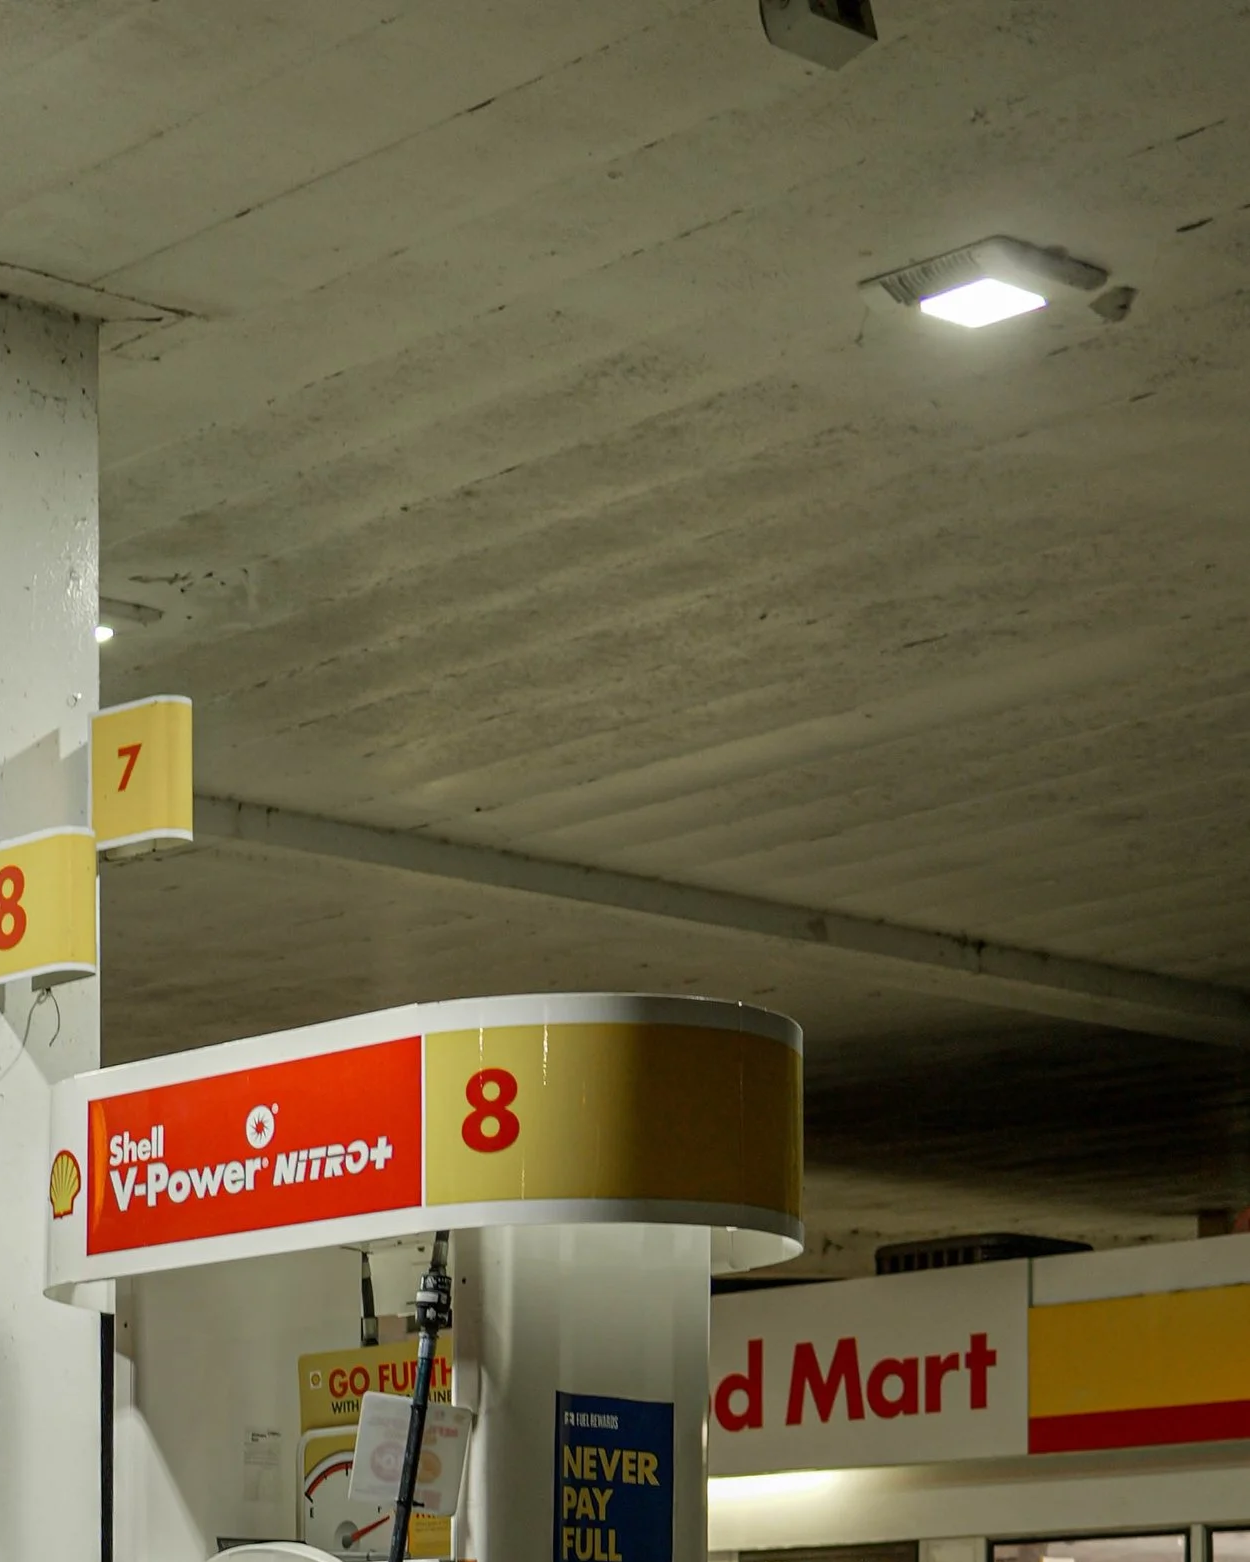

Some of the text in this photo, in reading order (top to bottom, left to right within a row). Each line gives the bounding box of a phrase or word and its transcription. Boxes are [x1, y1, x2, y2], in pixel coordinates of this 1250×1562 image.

[117, 743, 142, 792] 7
[461, 1067, 520, 1153] 8
[109, 1124, 164, 1166] Shell
[110, 1156, 263, 1212] V-Power
[329, 1366, 370, 1398] GO
[785, 1332, 997, 1426] Mart
[332, 1399, 359, 1414] WITH
[563, 1444, 660, 1486] NEVER
[563, 1486, 613, 1521] PAY
[563, 1526, 623, 1562] FULL
